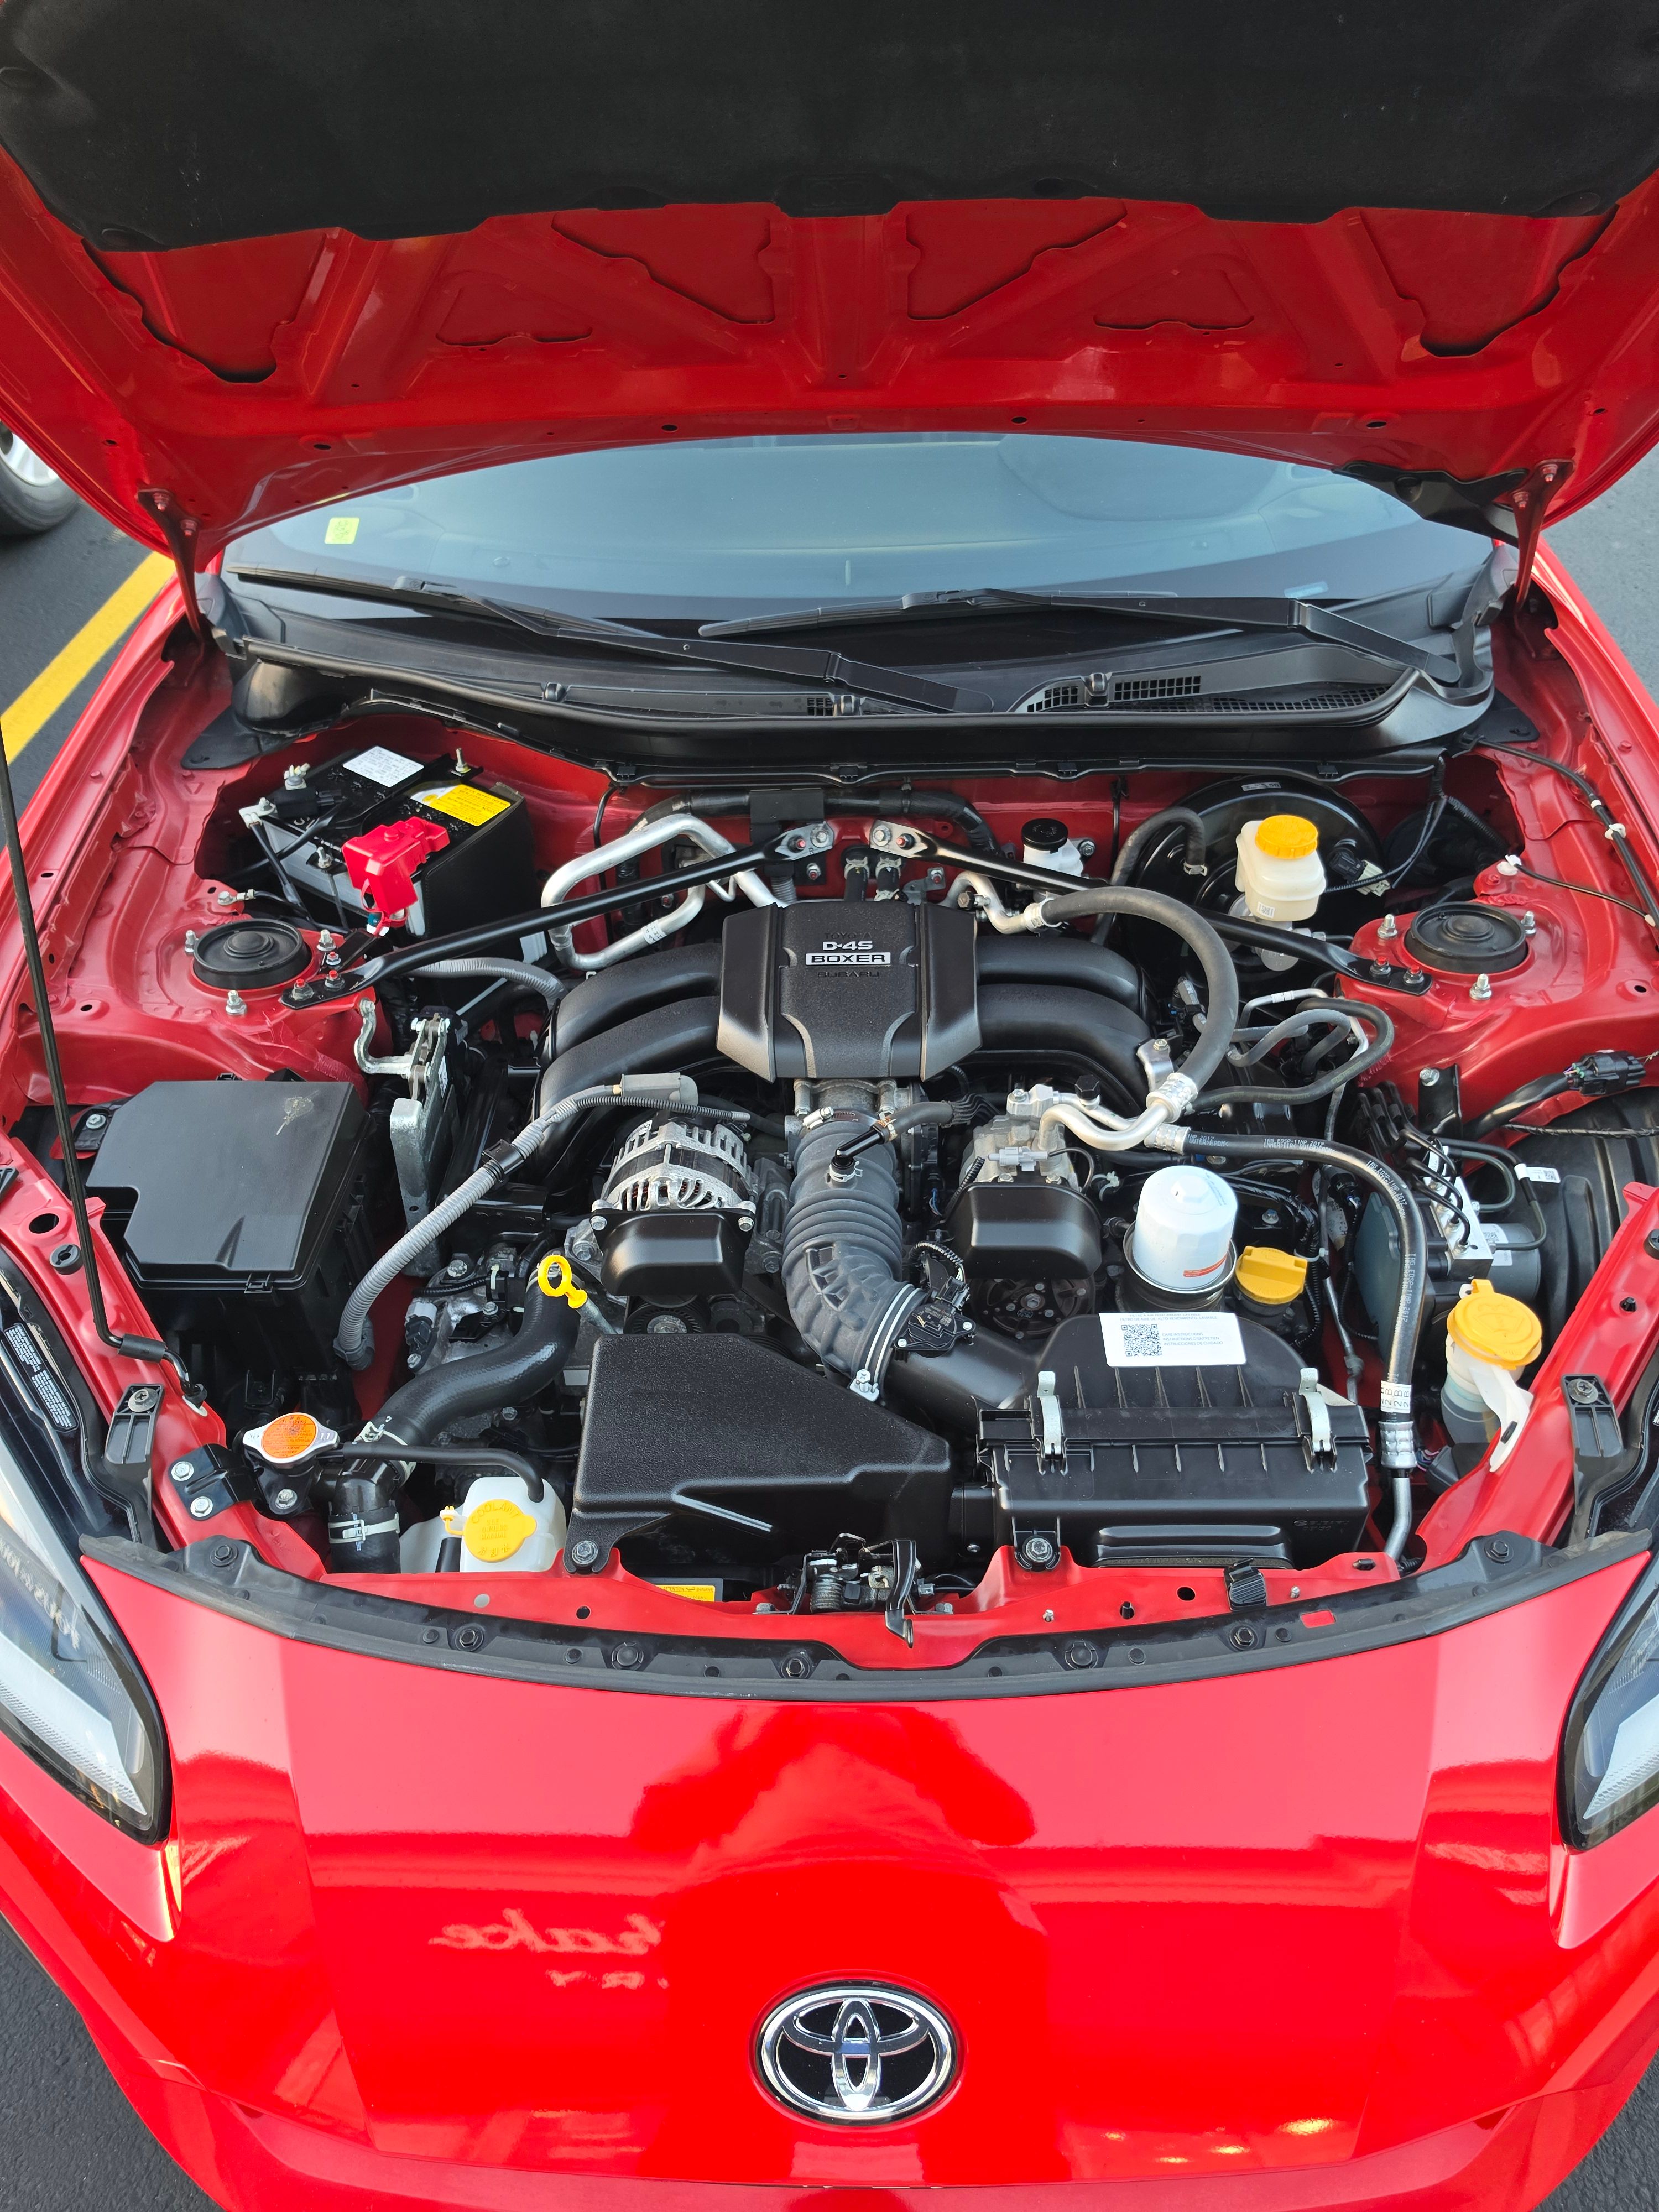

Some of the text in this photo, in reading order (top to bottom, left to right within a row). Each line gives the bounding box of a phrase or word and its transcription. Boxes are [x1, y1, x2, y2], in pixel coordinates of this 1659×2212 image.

[811, 954, 885, 963] BOXER
[471, 1501, 520, 1524] COOLANT
[481, 1531, 505, 1540] MANUAL
